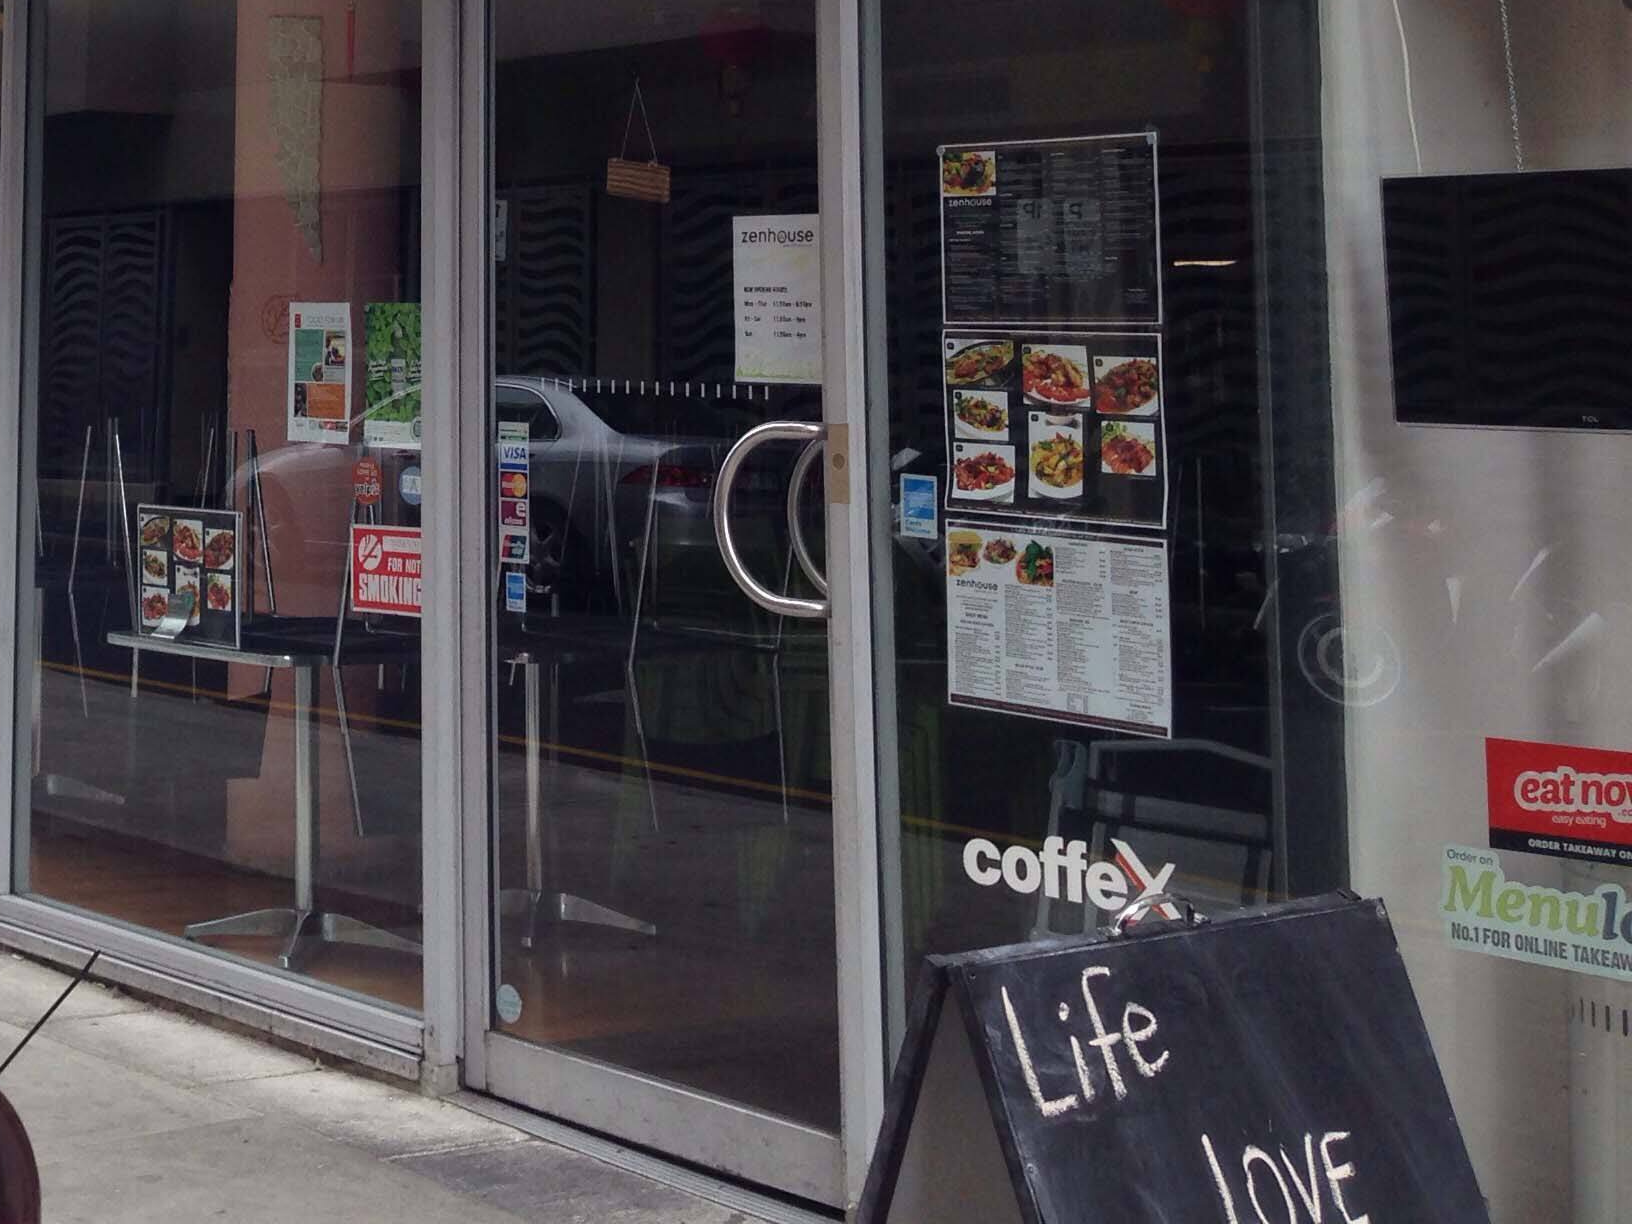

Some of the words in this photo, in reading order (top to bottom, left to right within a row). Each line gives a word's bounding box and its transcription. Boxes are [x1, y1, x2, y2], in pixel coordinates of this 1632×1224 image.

[741, 228, 814, 244] zenhouse
[503, 447, 527, 460] VISA
[387, 557, 403, 573] FOR
[405, 558, 421, 574] NOT
[956, 578, 999, 591] zenhouse
[1520, 773, 1575, 805] eat
[1551, 815, 1574, 826] easy
[1575, 815, 1607, 828] eating
[1446, 848, 1477, 864] Order
[1479, 856, 1494, 867] on
[1528, 838, 1561, 851] ORDER
[1563, 842, 1617, 859] TAKEAWAY
[1482, 927, 1511, 949] FOR
[1514, 933, 1568, 960] ONLINE
[1571, 944, 1632, 971] TAKEAW
[1000, 965, 1170, 1117] Life
